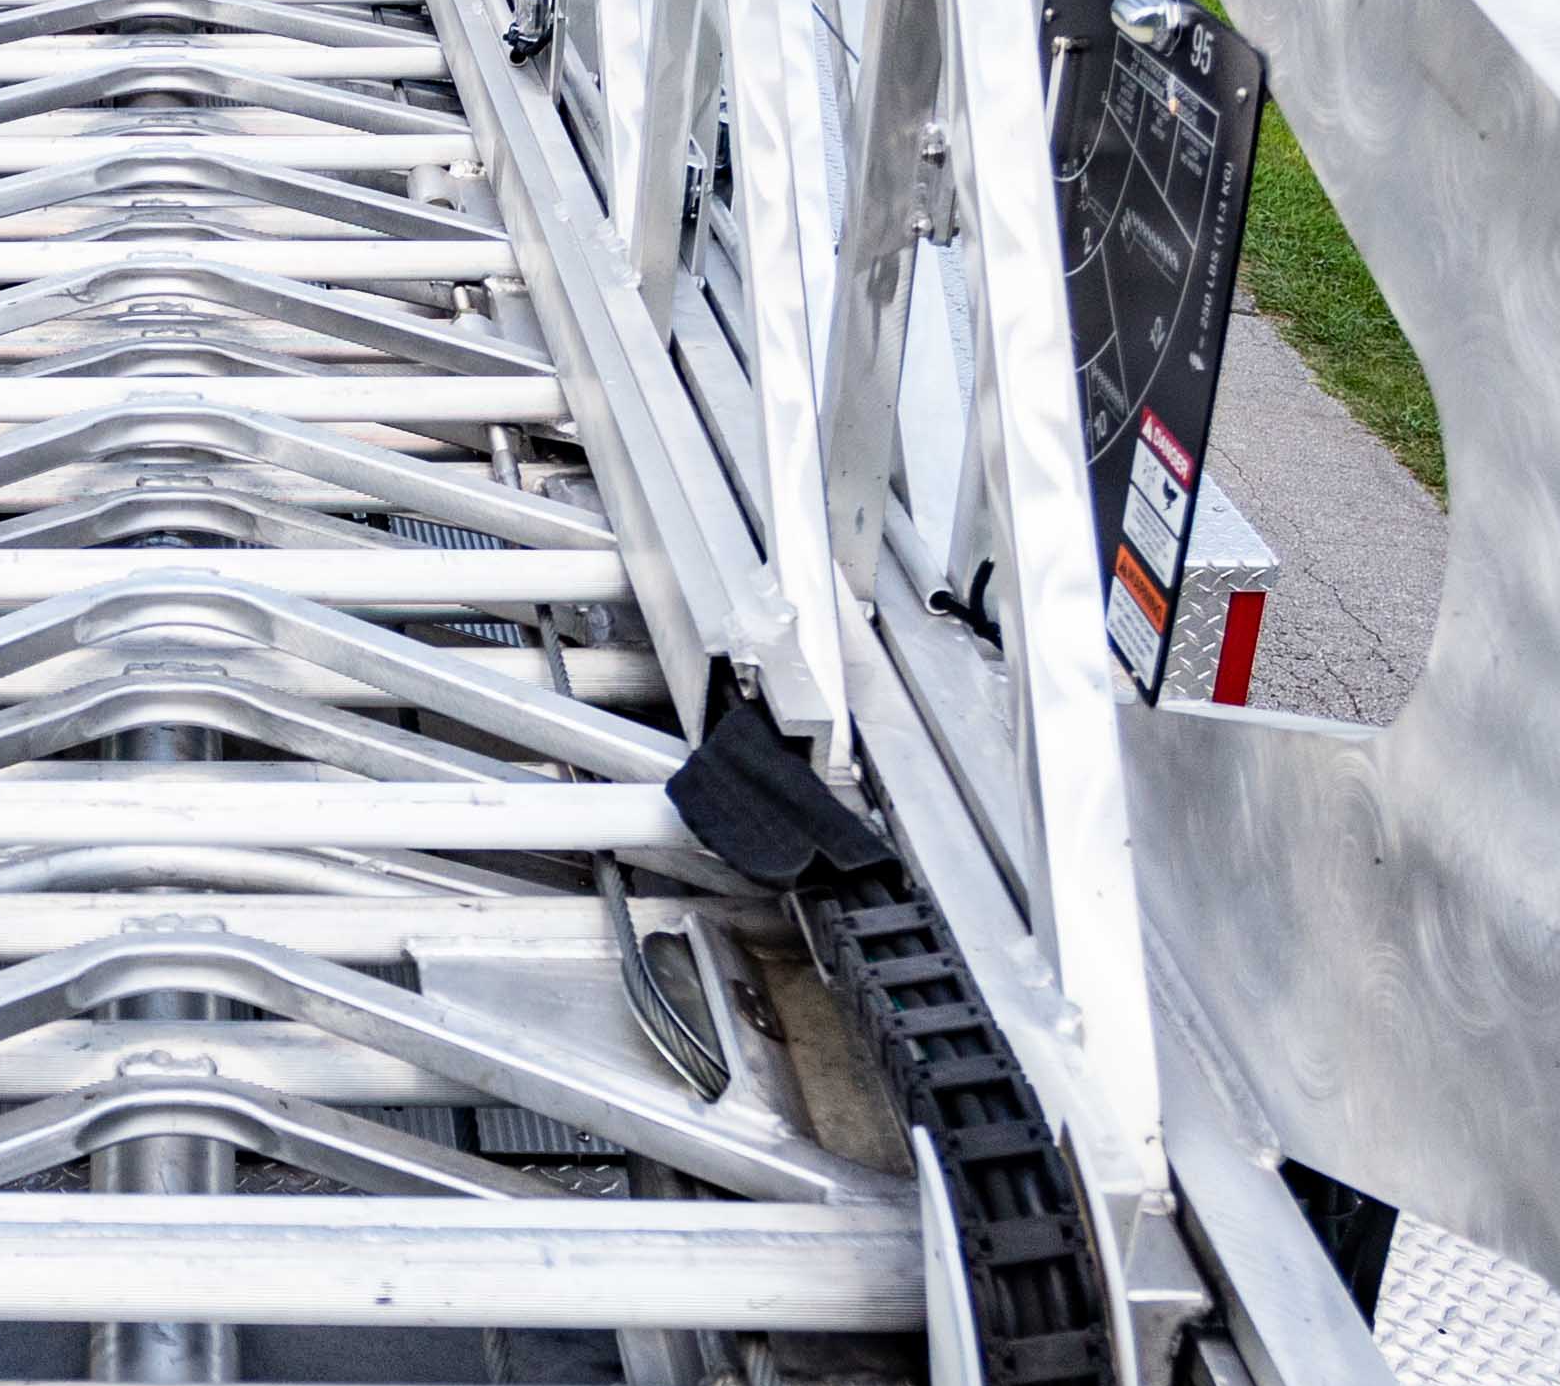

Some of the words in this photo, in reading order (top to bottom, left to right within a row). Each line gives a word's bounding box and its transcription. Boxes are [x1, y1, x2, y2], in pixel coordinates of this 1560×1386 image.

[1190, 24, 1215, 75] 95
[1206, 249, 1220, 289] LBS
[1221, 162, 1235, 196] KG)
[1152, 426, 1189, 481] DANGER
